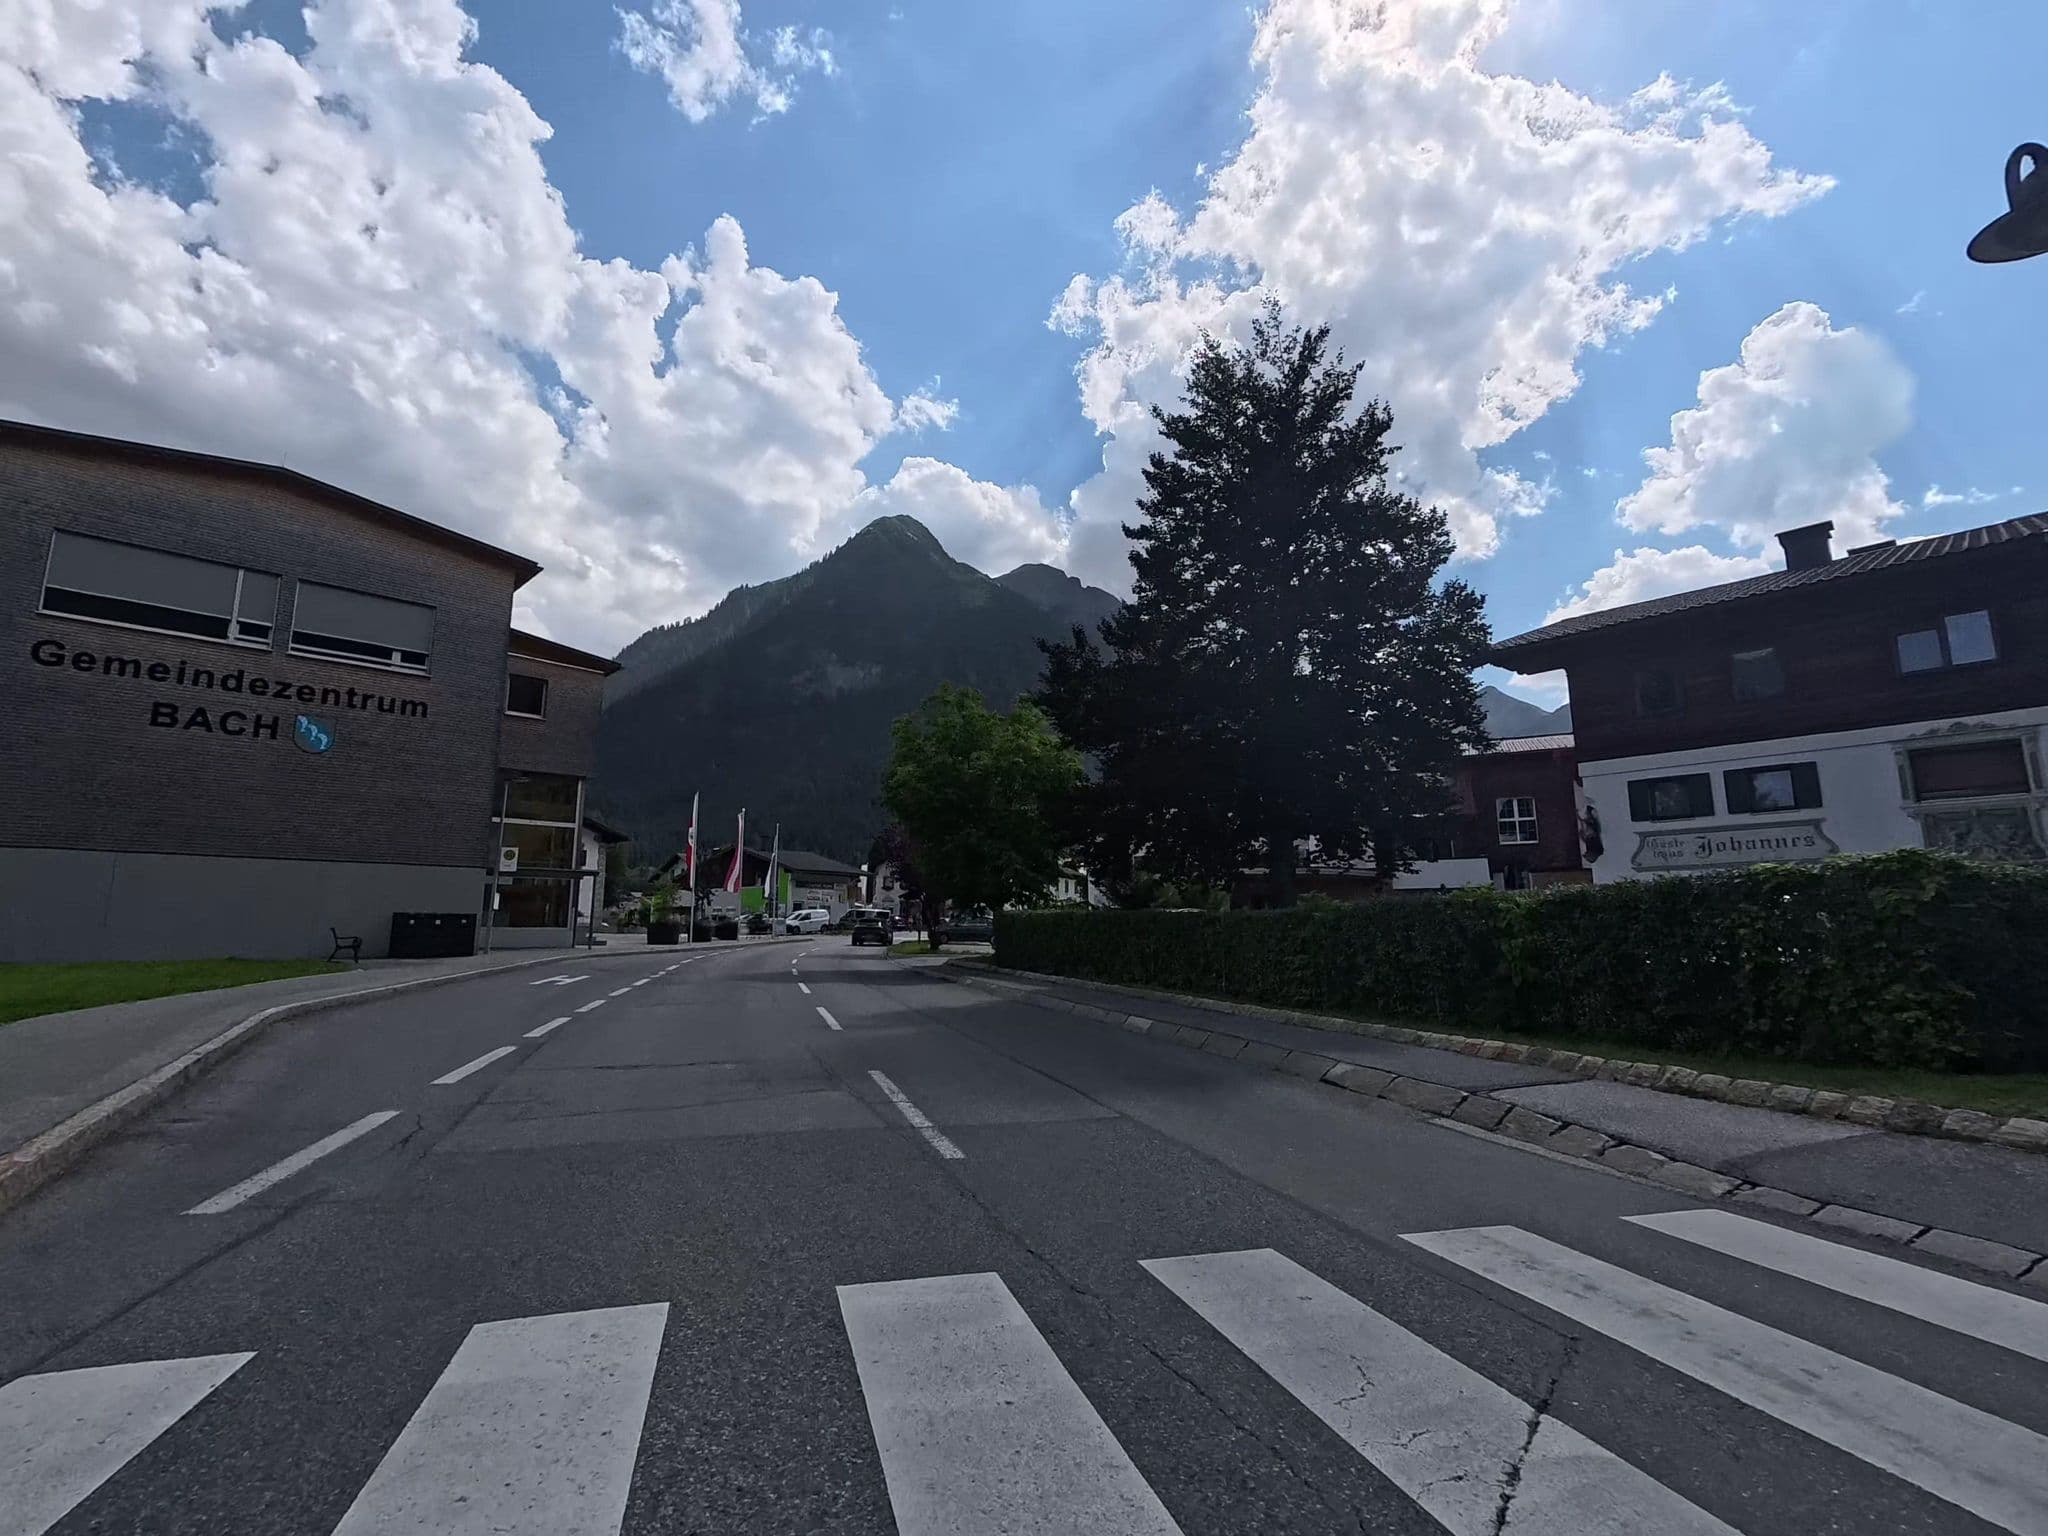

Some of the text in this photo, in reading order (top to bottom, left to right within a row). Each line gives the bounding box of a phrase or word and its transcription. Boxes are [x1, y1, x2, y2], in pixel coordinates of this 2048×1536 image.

[30, 639, 429, 718] Gemeindezentrum
[148, 701, 280, 740] BACH
[1694, 834, 1816, 858] Johannes
